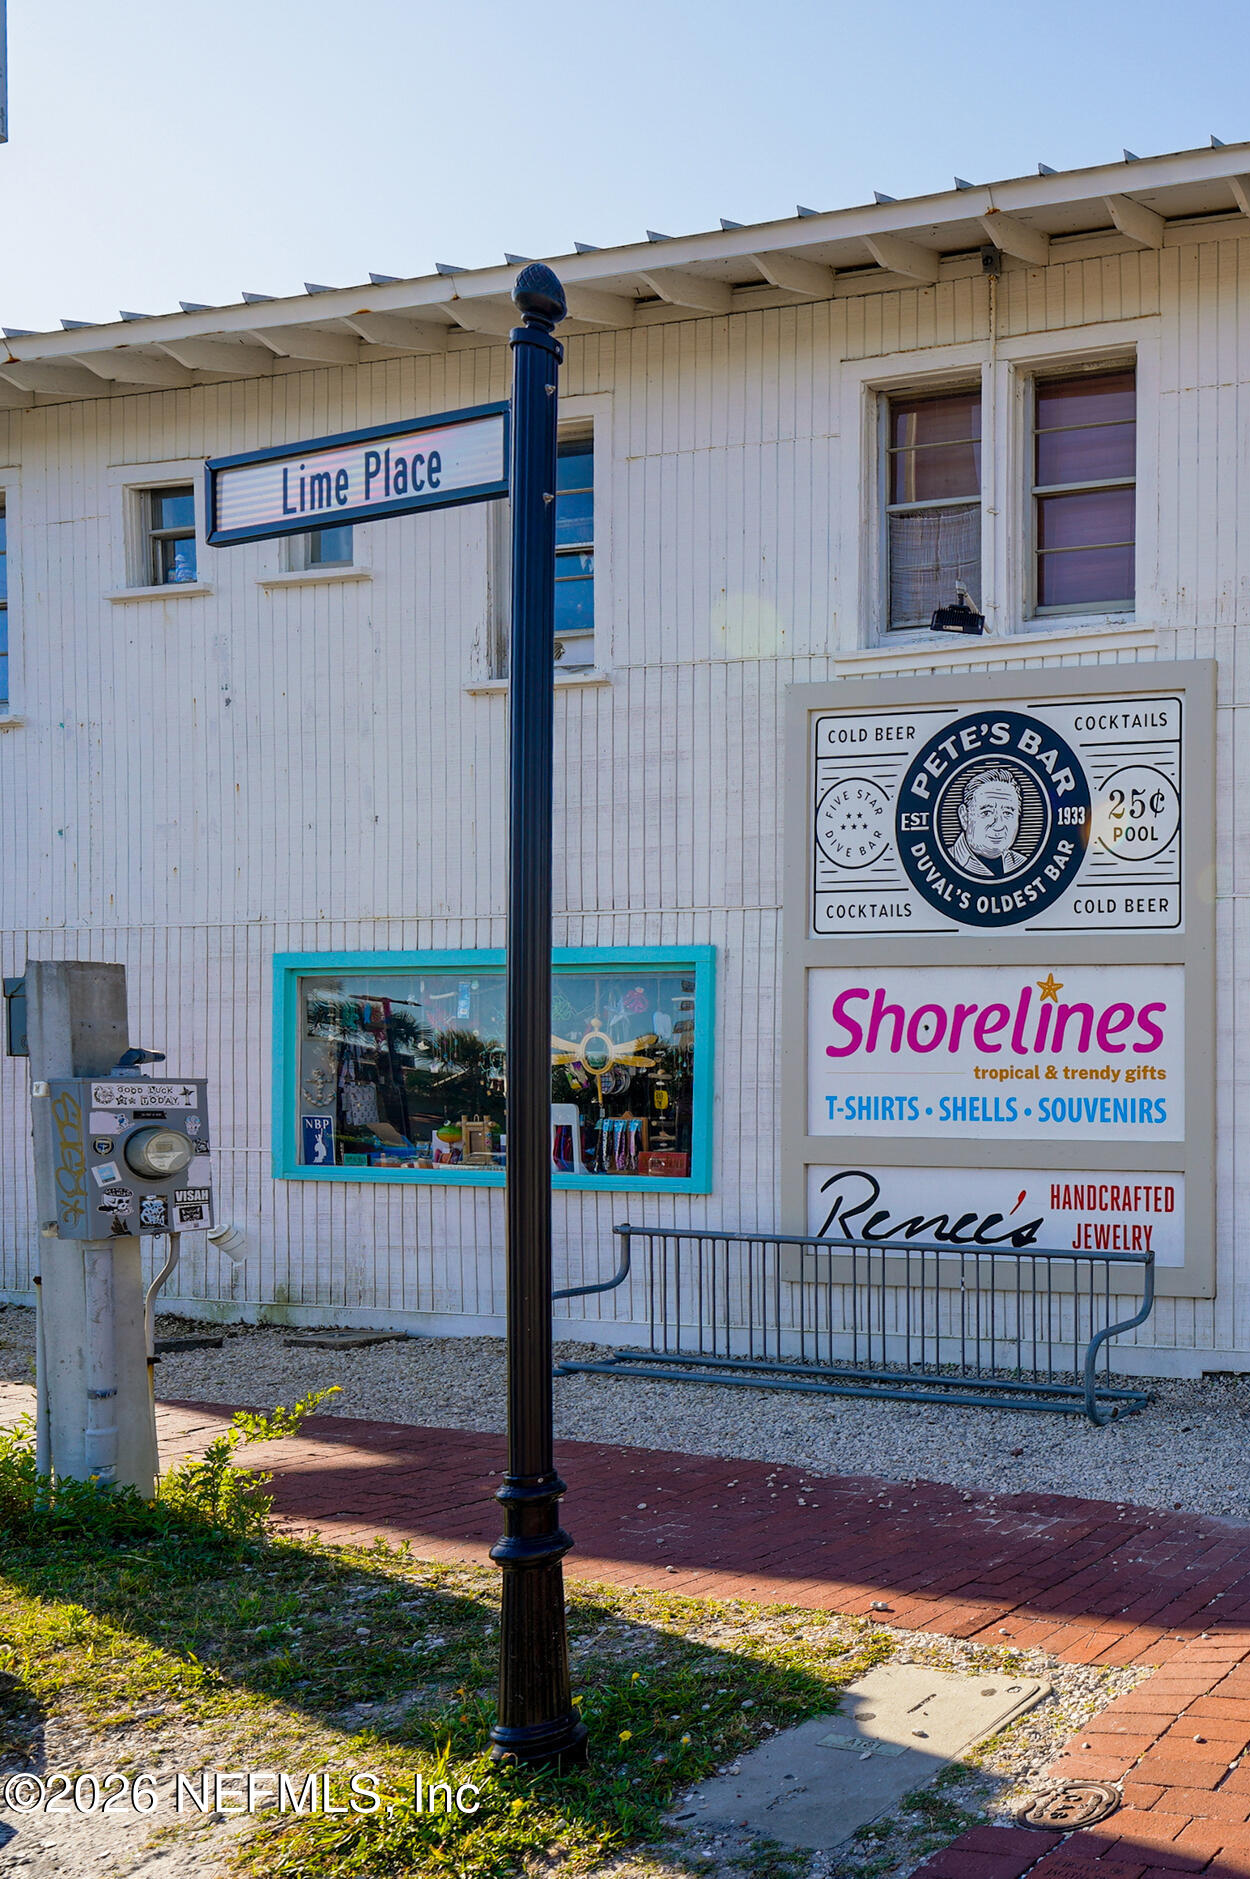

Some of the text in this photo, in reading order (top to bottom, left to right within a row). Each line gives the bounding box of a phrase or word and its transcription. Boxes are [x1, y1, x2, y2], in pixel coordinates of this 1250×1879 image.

[282, 448, 442, 515] Lime Place
[1074, 712, 1168, 731] COCKTAILS
[828, 726, 916, 744] COLD BEER
[911, 722, 1076, 800] PETE'S BAR
[825, 789, 884, 820] FIVE STAR
[1057, 806, 1086, 826] 1933
[1108, 788, 1165, 820] 25¢
[901, 812, 930, 831] EST
[825, 829, 884, 859] DIVE BAR
[1113, 826, 1159, 842] POOL
[910, 838, 1075, 915] DUVAL'S OLDEST BAR
[826, 903, 912, 919] COCKTAILS
[1074, 898, 1169, 914] COLD BEER
[825, 985, 1167, 1058] Shorelines
[973, 1065, 1167, 1083] tropical & trendy gifts
[825, 1095, 1167, 1124] T-SHIRTS SHELLS SOUVENIRS
[305, 1118, 329, 1130] NBP
[175, 1189, 209, 1202] VISAH
[1050, 1184, 1175, 1213] HANDCRAFTED
[1072, 1223, 1153, 1251] JEWELRY
